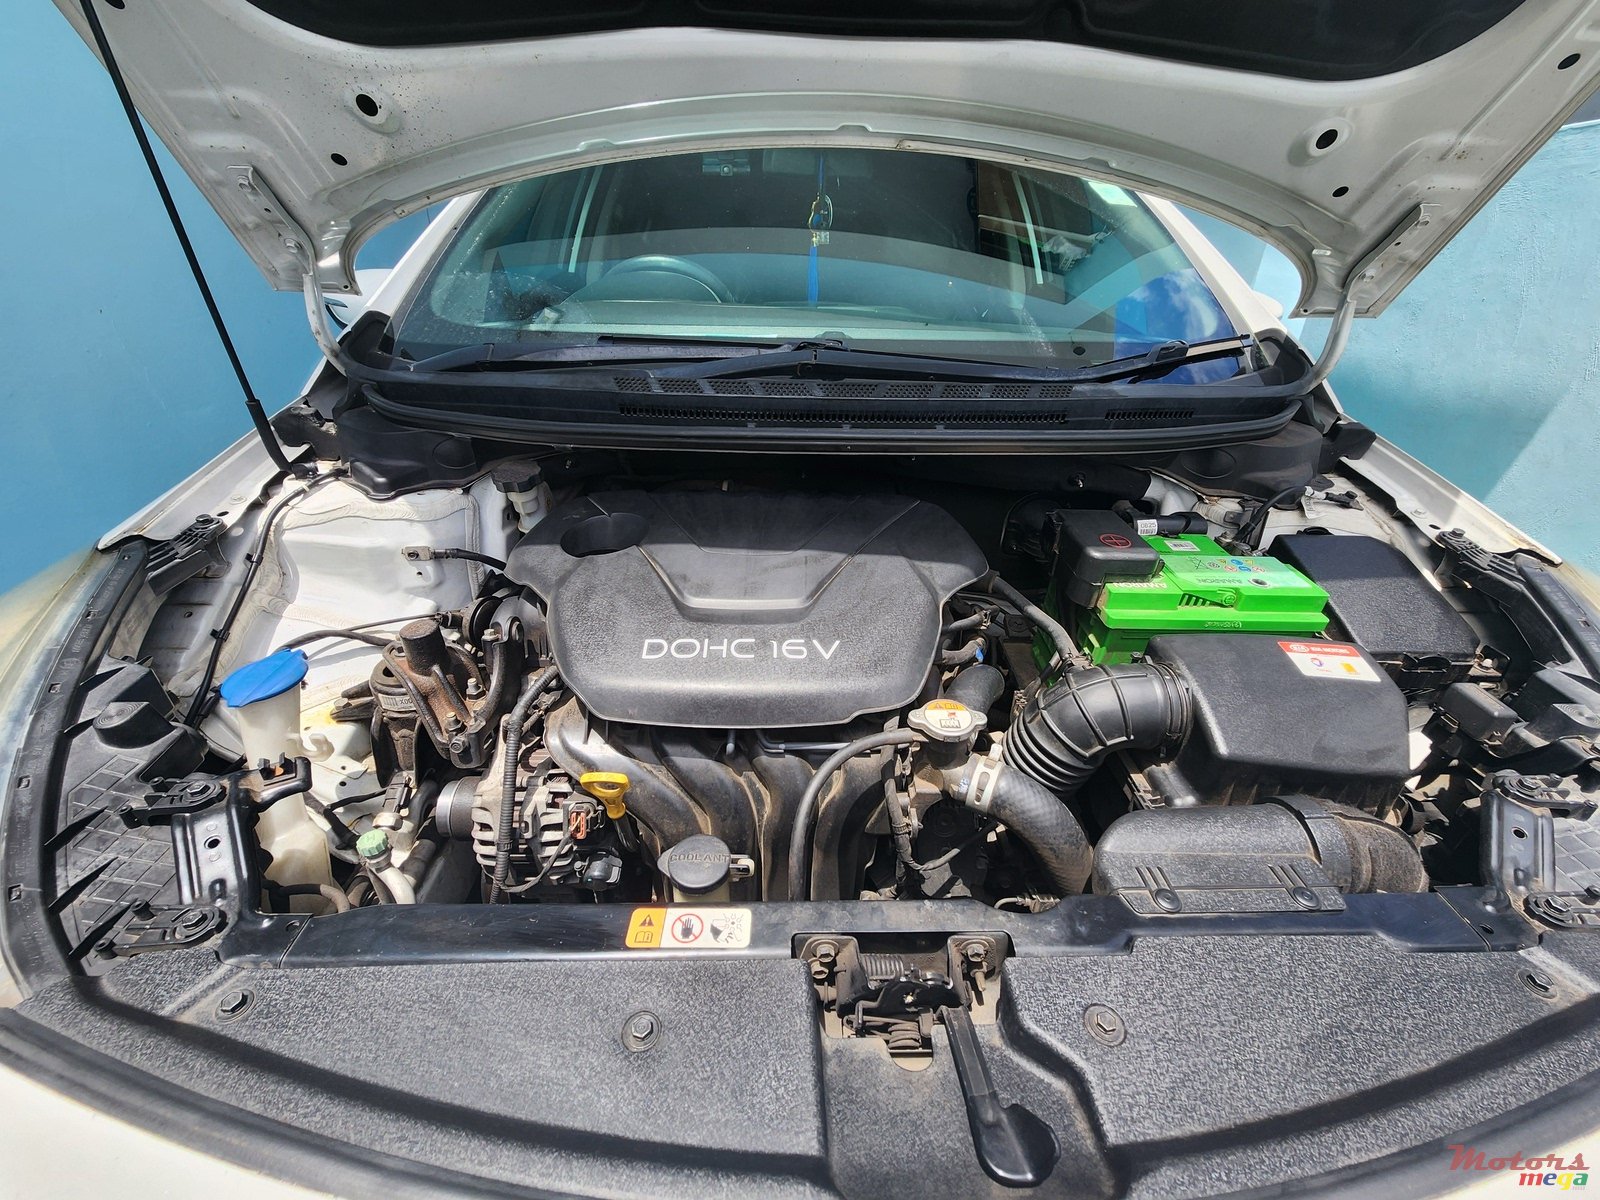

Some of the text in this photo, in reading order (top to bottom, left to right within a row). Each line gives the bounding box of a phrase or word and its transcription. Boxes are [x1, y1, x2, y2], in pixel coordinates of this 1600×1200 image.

[642, 638, 840, 660] DOHC 16V
[670, 853, 731, 863] COOLANT
